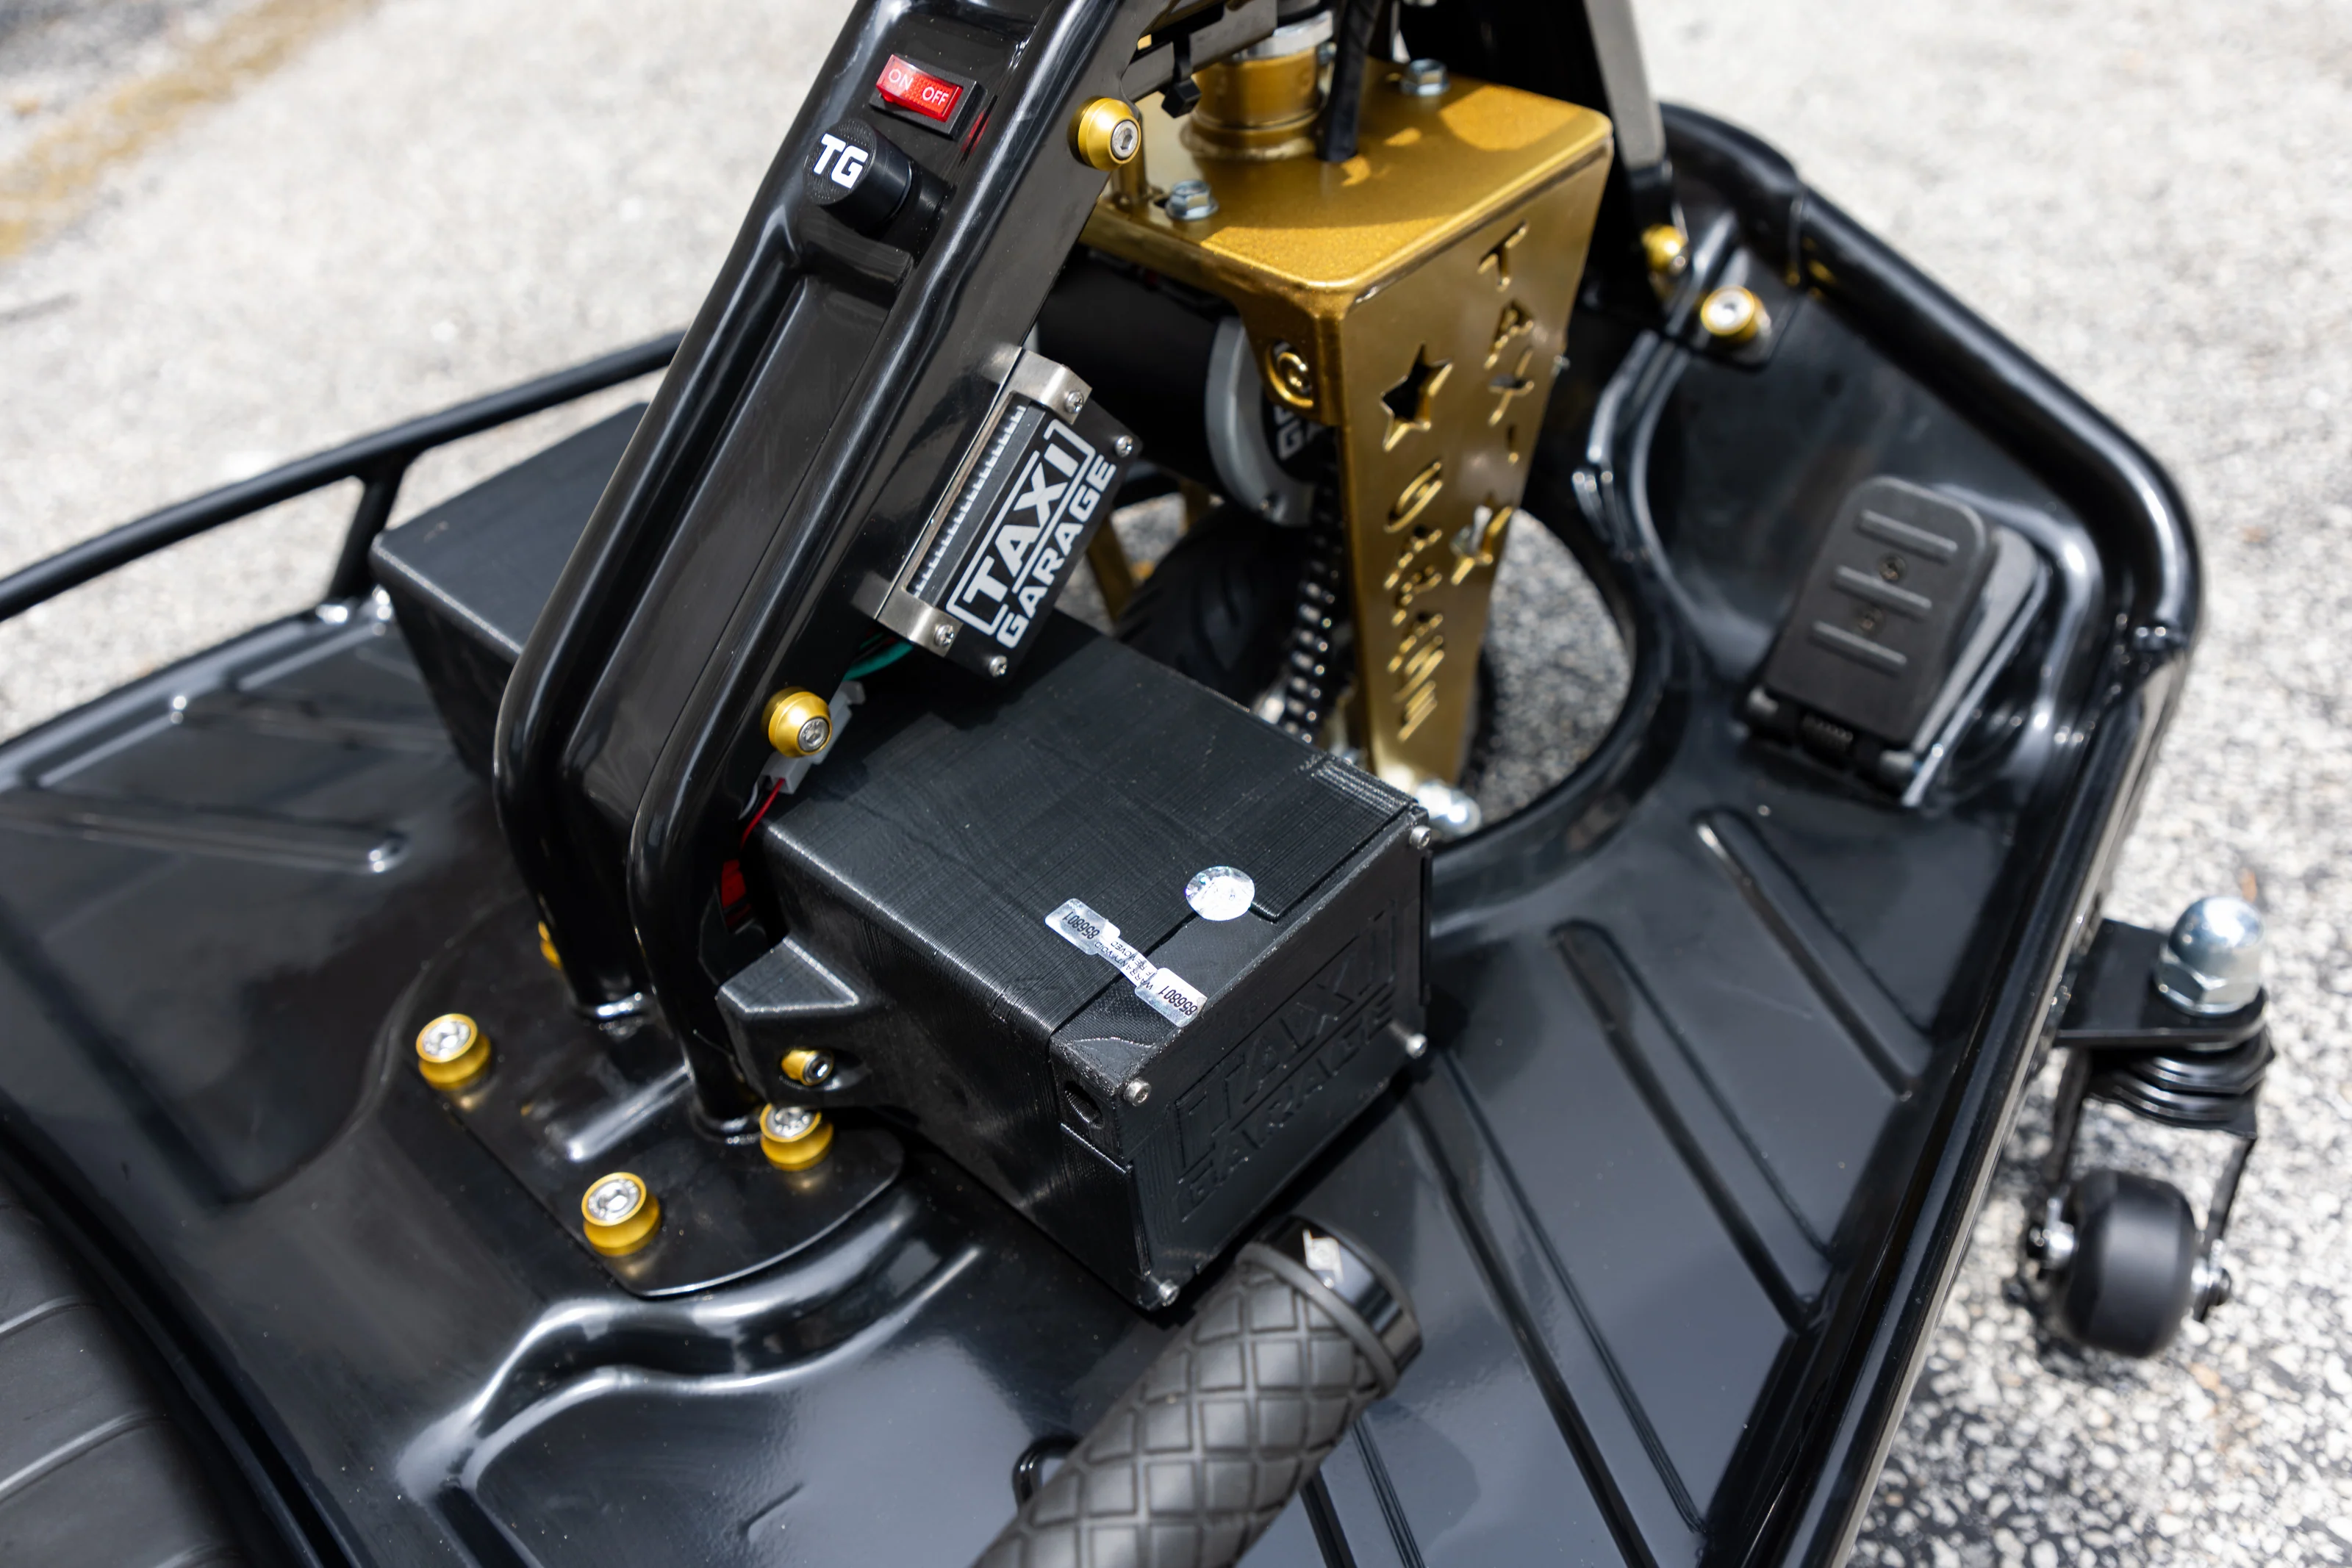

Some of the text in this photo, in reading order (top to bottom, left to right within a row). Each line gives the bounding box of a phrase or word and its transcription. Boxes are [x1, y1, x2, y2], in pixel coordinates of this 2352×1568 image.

[888, 68, 949, 105] ON OFF
[813, 133, 869, 189] TG
[962, 442, 1079, 603] TAXI
[997, 454, 1116, 648] GARAGE
[1063, 911, 1100, 940] 856801
[1094, 941, 1154, 990] WARRANTY VOID
[1111, 941, 1147, 971] REMOVED
[1158, 985, 1198, 1016] 856801
